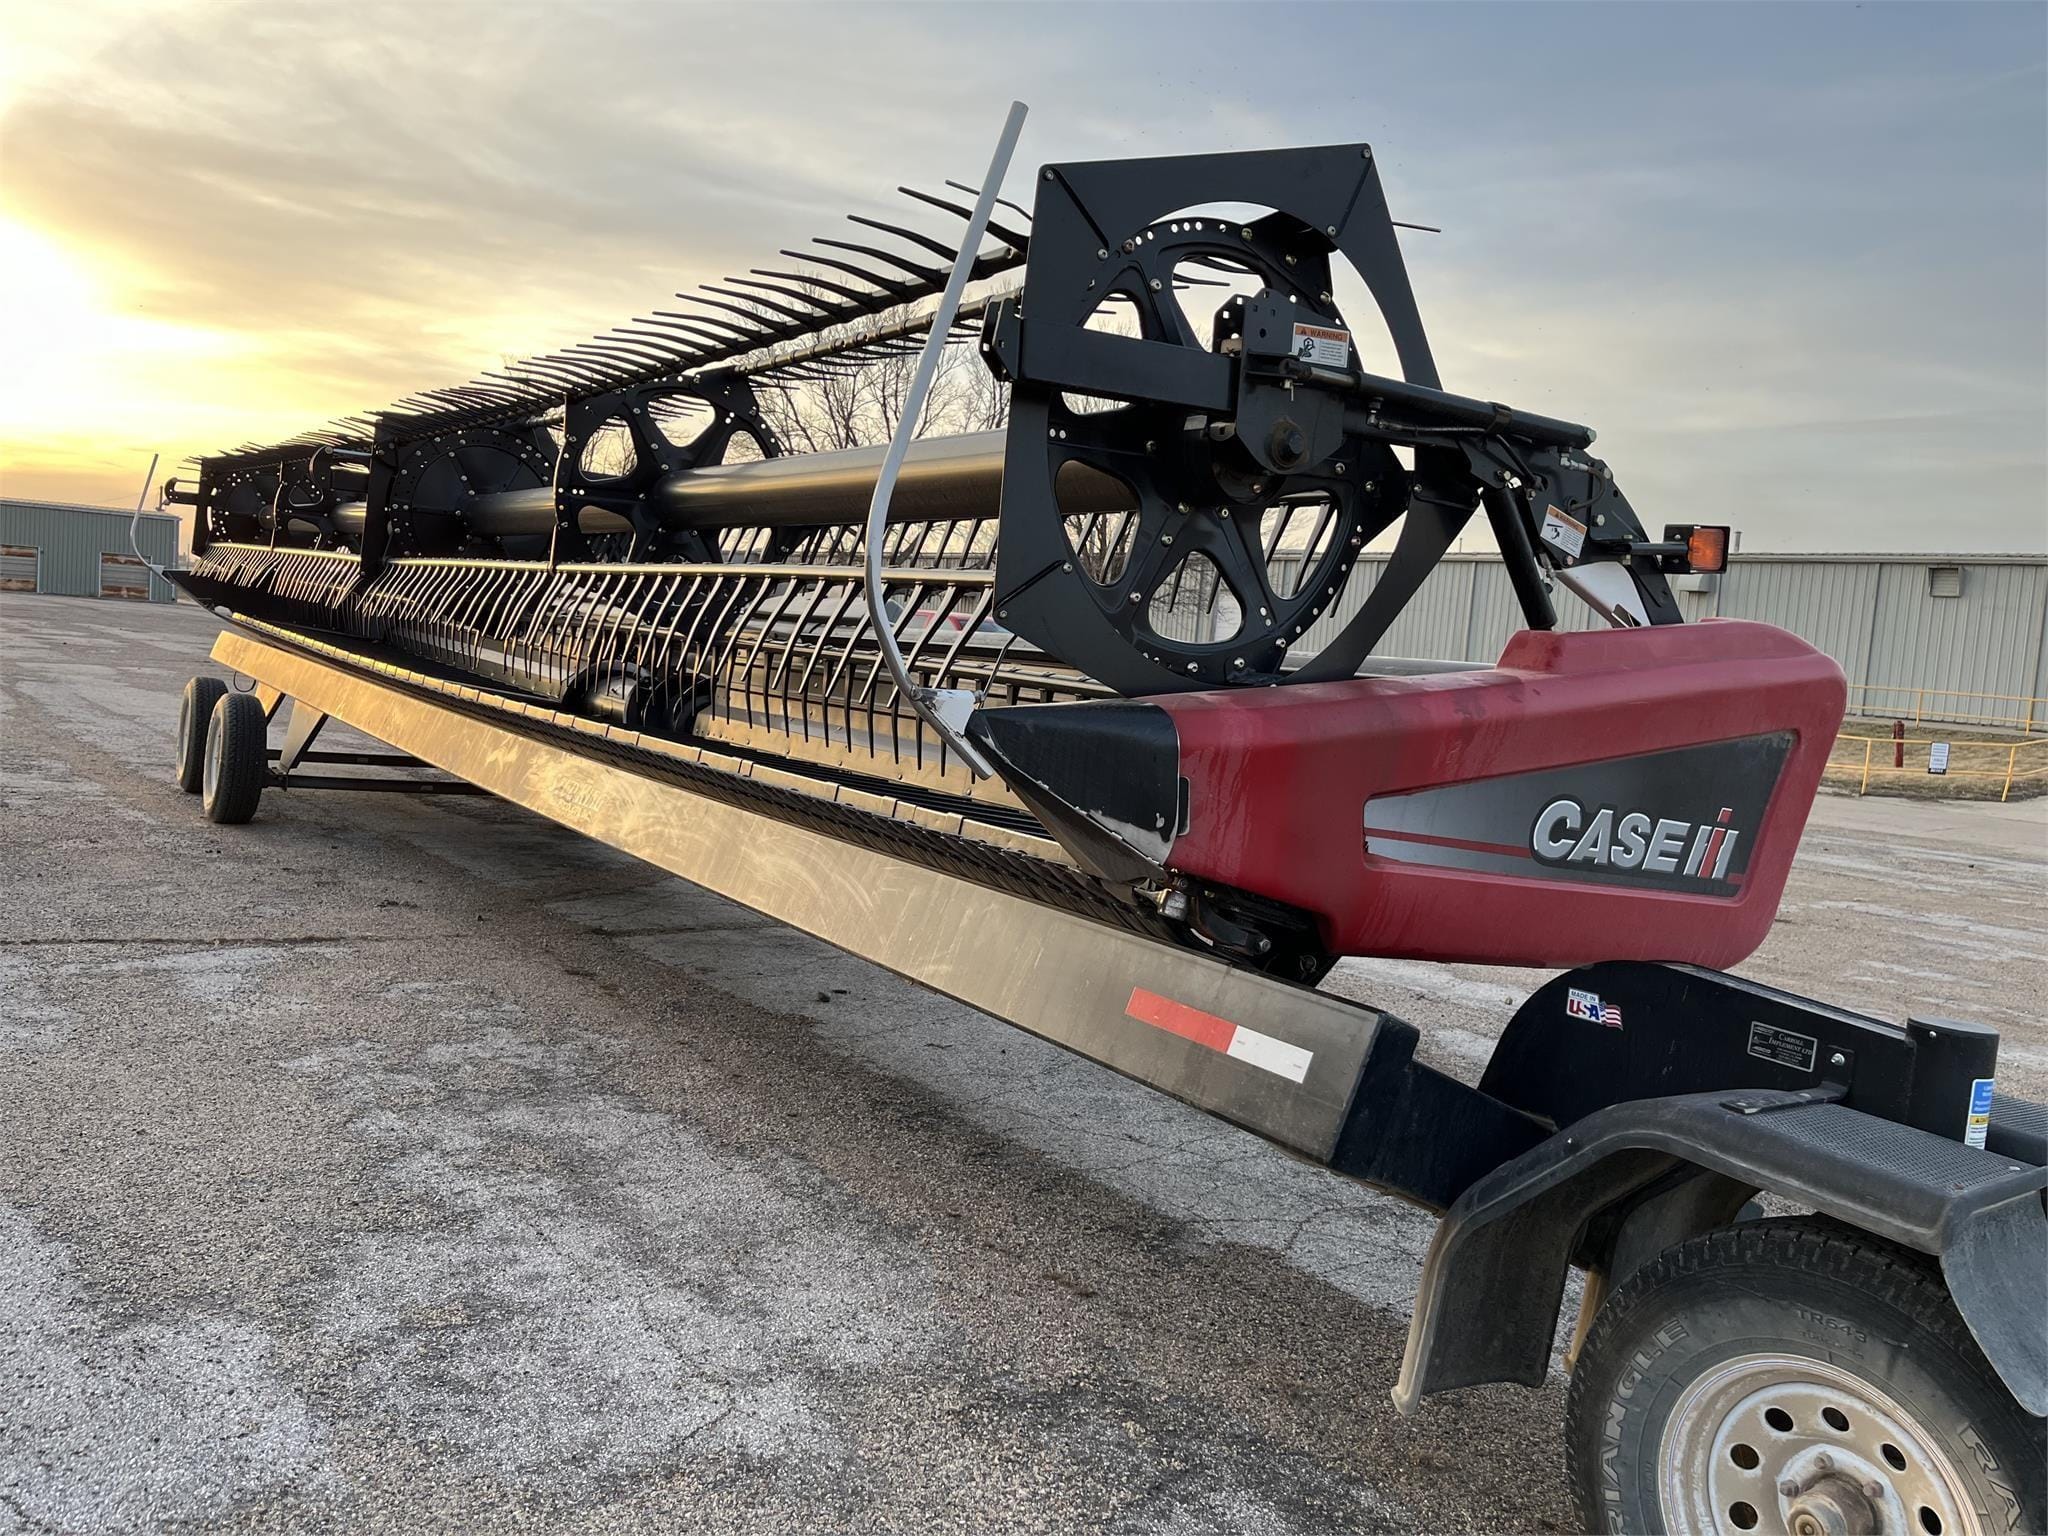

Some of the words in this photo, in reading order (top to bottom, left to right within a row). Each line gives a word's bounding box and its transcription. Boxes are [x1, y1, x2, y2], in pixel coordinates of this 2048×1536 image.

[1310, 328, 1343, 341] WARNING
[1571, 990, 1588, 1000] MADE
[1569, 998, 1600, 1021] USA
[1768, 1036, 1802, 1053] IMPLEMENT
[1792, 1308, 1867, 1343] TR643
[1601, 1319, 1688, 1536] RIANGLE
[1958, 1423, 2023, 1532] RA
